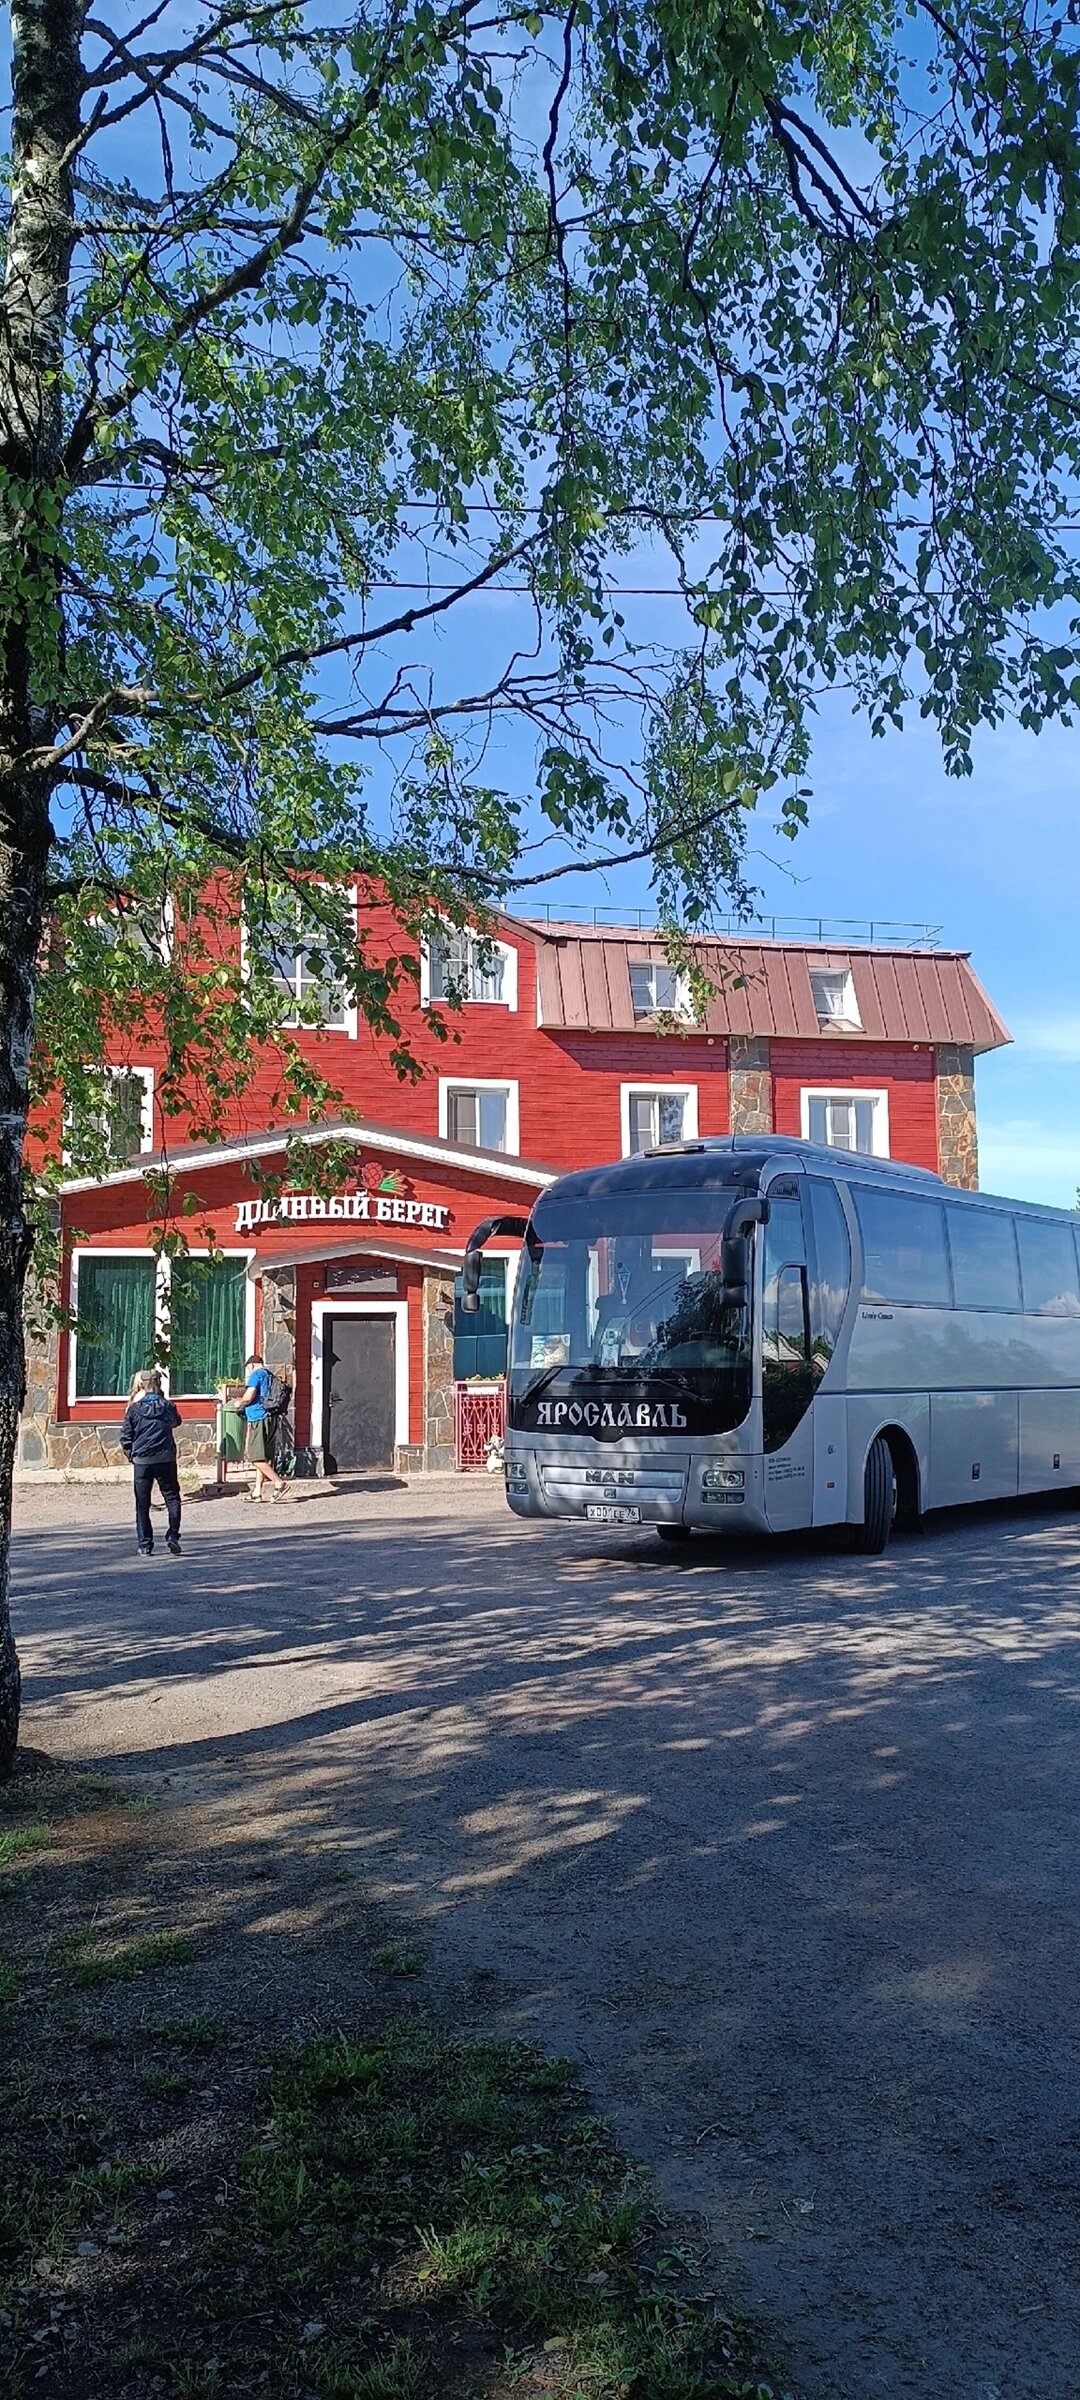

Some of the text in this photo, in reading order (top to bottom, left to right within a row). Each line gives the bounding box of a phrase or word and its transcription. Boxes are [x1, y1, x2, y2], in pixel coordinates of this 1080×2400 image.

[233, 1189, 449, 1232] ДЛИННЫЙ БЕРЕГ
[536, 1401, 687, 1427] ЯРОСЛАВЛЬ
[585, 1470, 635, 1485] MAN
